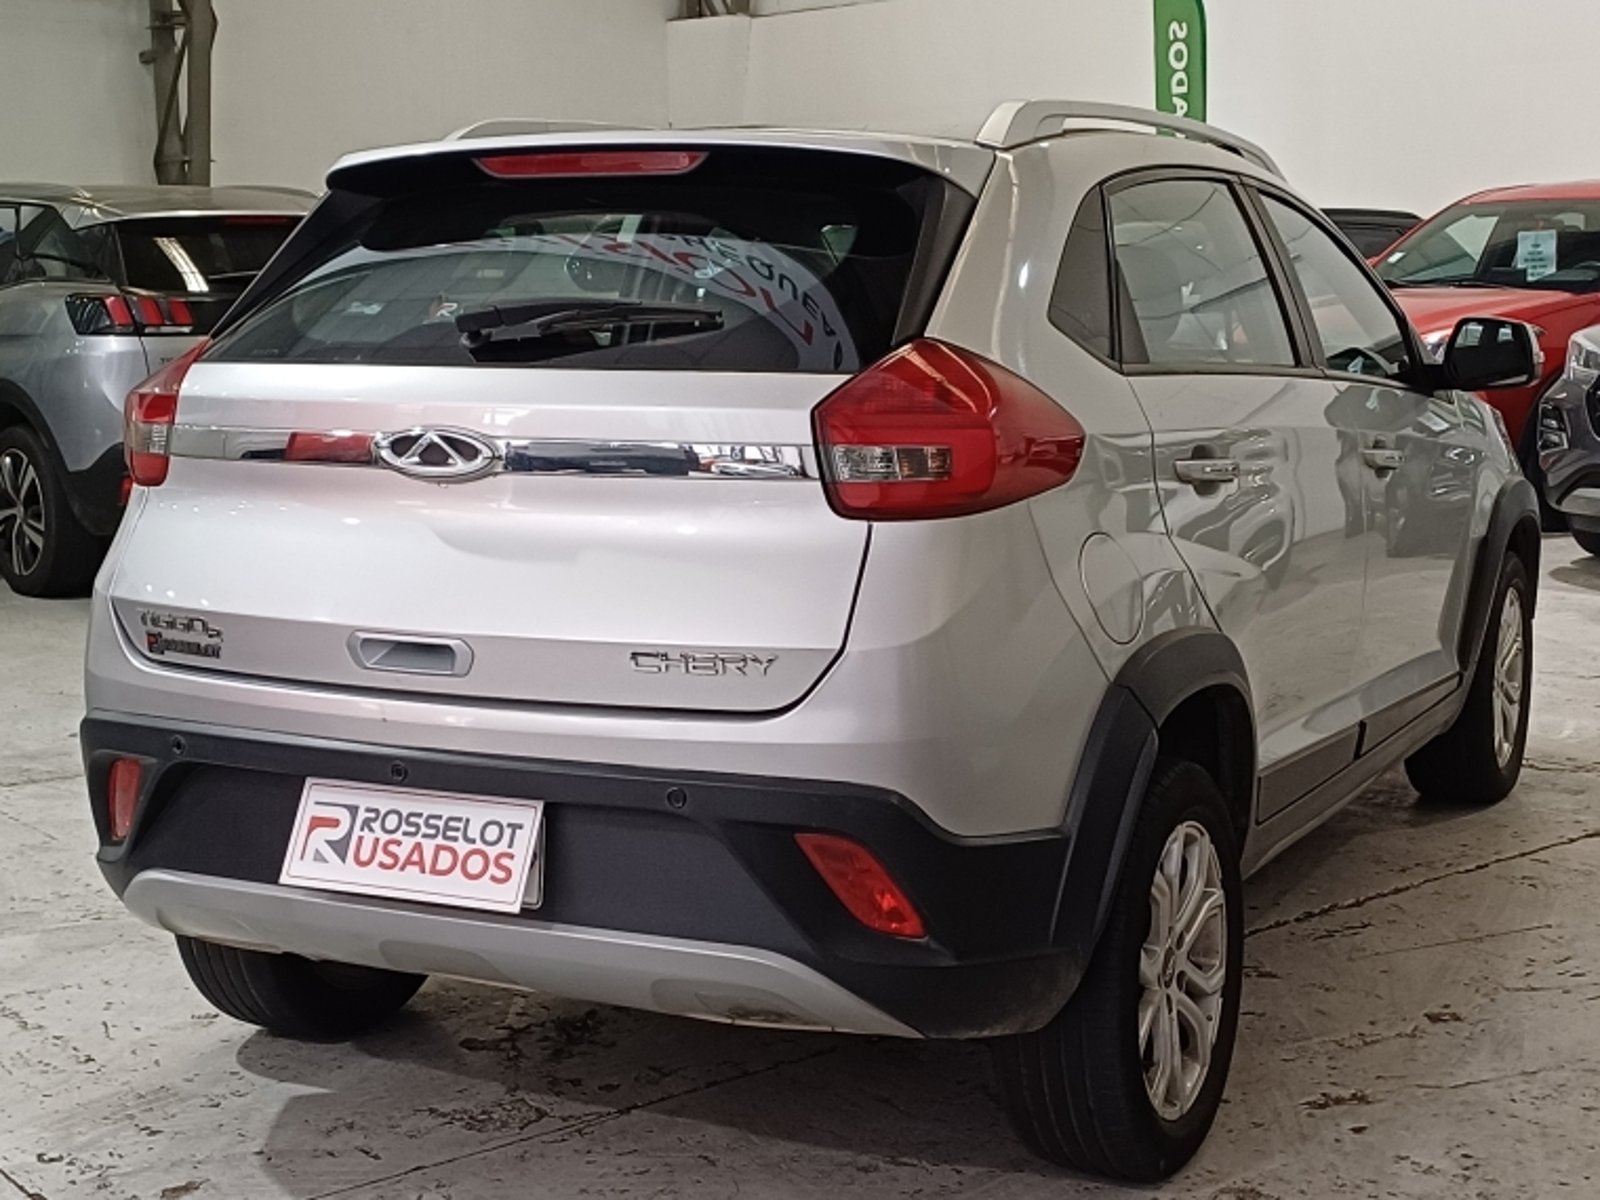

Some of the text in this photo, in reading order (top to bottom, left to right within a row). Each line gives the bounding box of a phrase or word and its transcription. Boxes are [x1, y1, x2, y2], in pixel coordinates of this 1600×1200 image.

[629, 651, 779, 677] CHERY
[359, 806, 524, 849] ROSSELOT
[353, 835, 516, 885] USADOS
